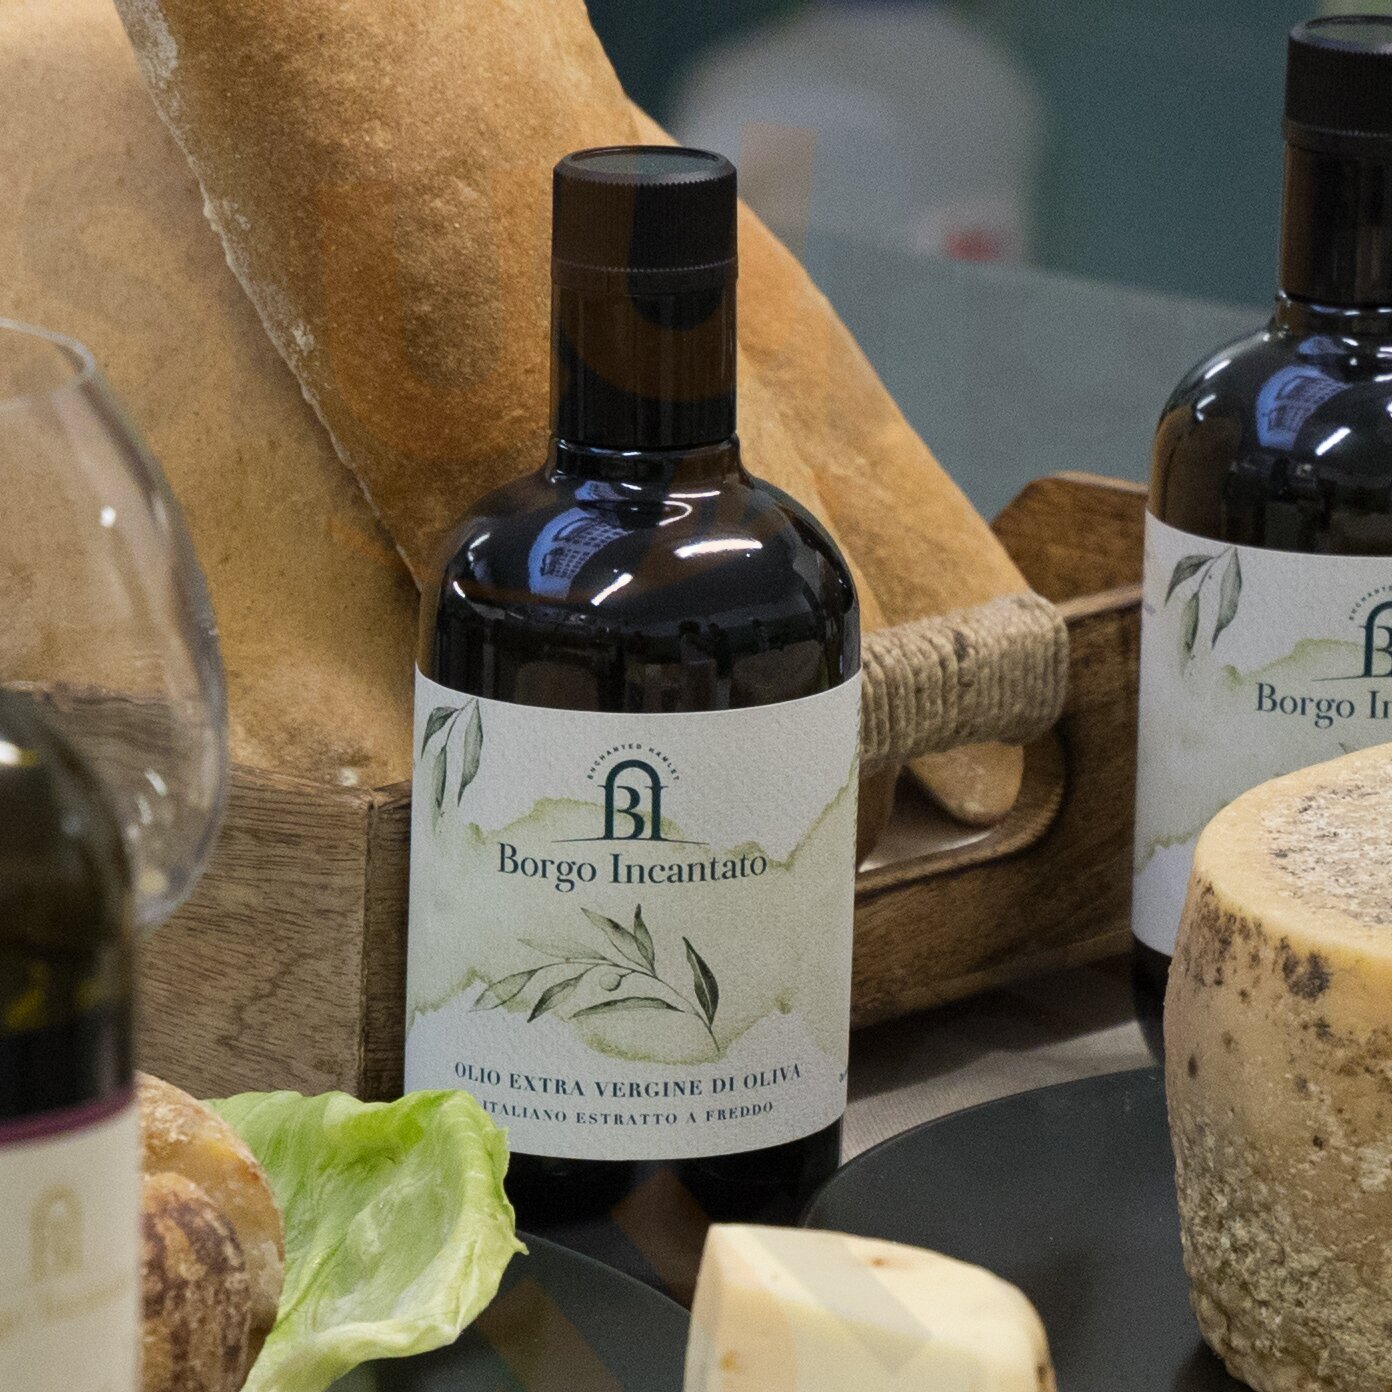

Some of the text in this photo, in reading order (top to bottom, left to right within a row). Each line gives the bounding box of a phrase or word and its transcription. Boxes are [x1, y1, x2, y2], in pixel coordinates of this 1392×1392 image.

[1255, 682, 1355, 729] Borgo
[586, 743, 680, 781] ENCHANTED HAMLET
[497, 842, 768, 893] Borgo Incantato
[454, 1061, 802, 1098] OLIO EXTRA VERGINE DI OLIVA
[482, 1099, 774, 1126] ITALIANO ESTRATTO A FREDDO
